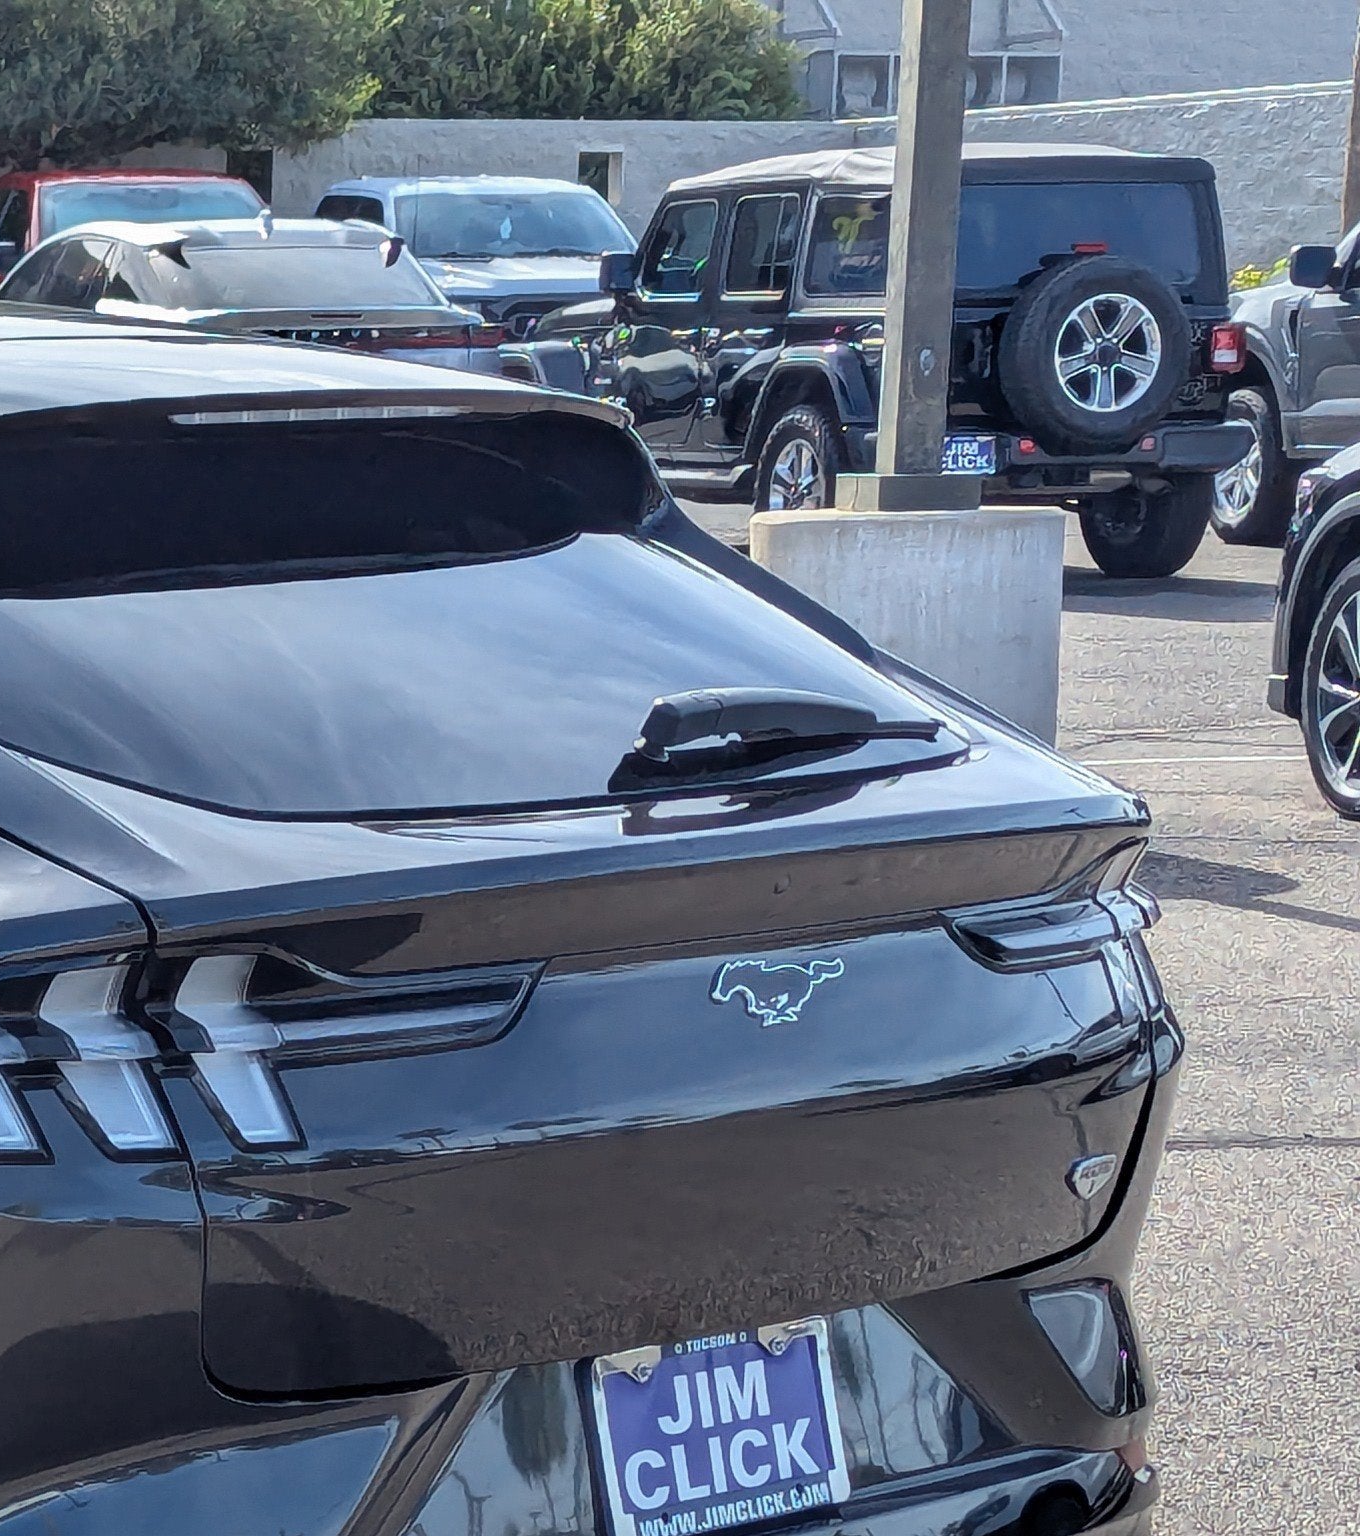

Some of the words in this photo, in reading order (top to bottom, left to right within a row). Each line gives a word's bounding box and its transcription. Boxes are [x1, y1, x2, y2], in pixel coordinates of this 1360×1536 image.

[946, 441, 979, 456] JIM
[686, 1332, 736, 1353] TUCSON
[657, 1359, 771, 1436] JIM
[624, 1417, 821, 1511] CLICK
